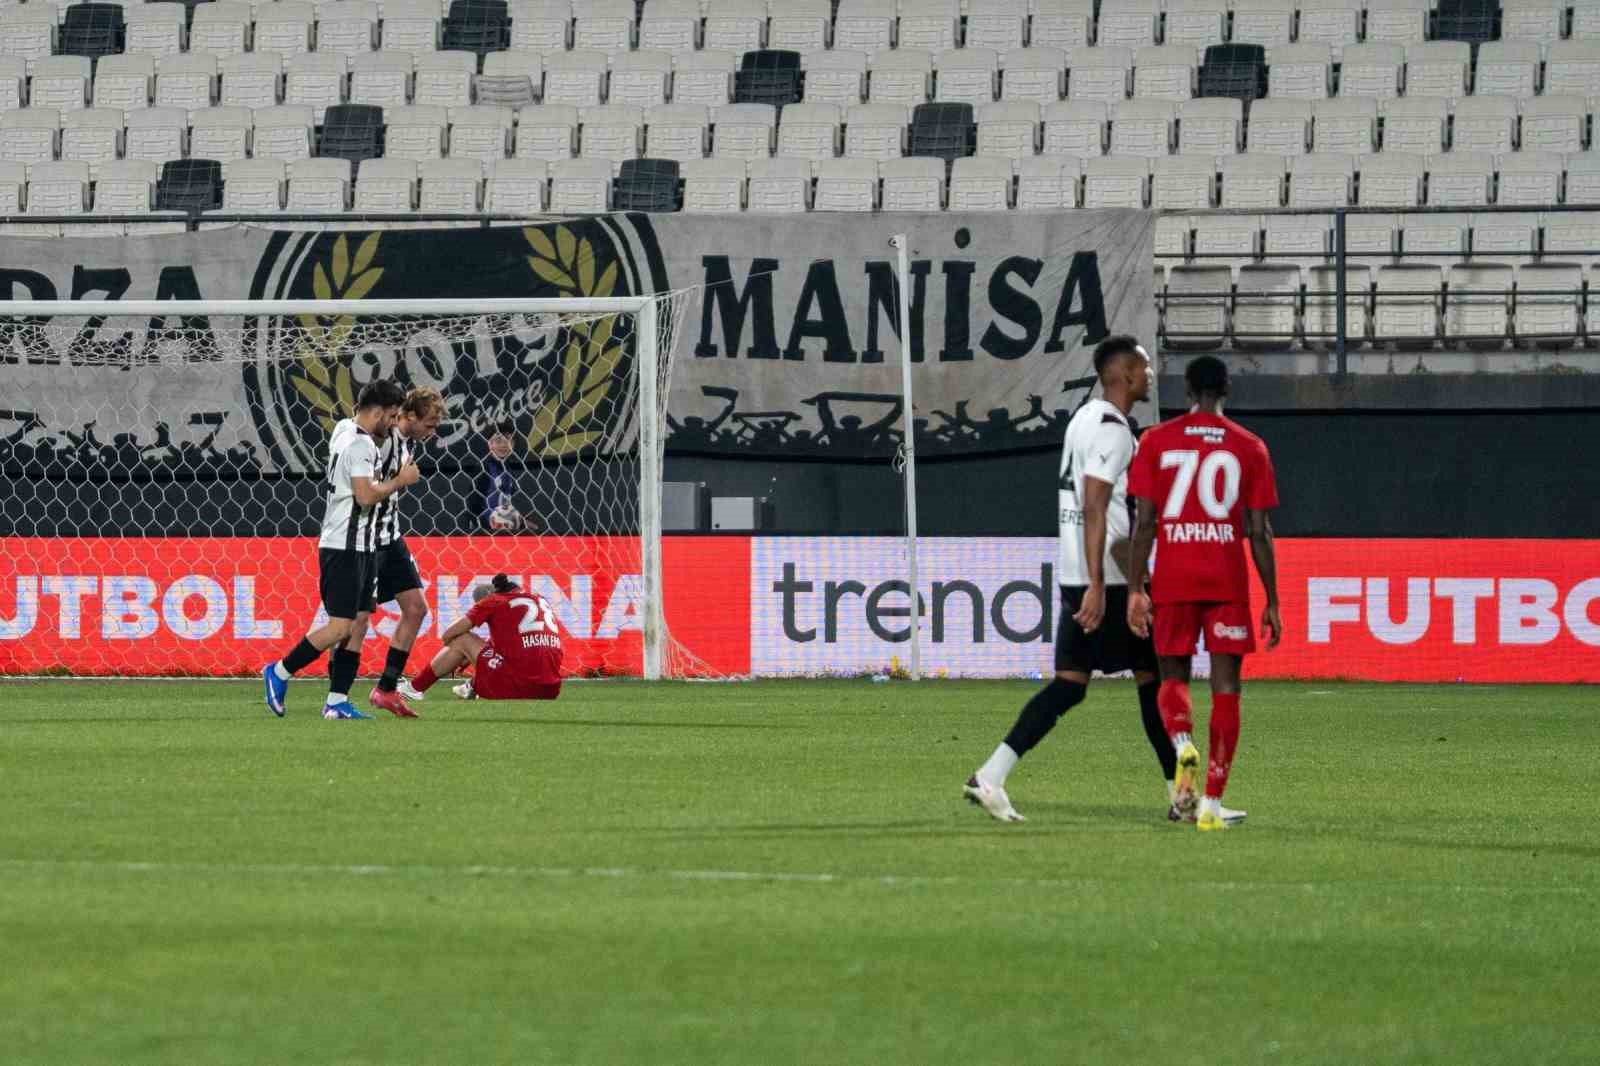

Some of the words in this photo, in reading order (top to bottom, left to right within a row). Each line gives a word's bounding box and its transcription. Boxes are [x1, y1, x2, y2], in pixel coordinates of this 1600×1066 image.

[695, 227, 1109, 362] MANİSA
[436, 379, 545, 448] Since
[1160, 449, 1241, 520] 70
[1163, 522, 1235, 544] TAPHAIR
[773, 562, 1053, 643] trend
[1307, 577, 1600, 645] FUTBO
[522, 634, 549, 648] HASAN
